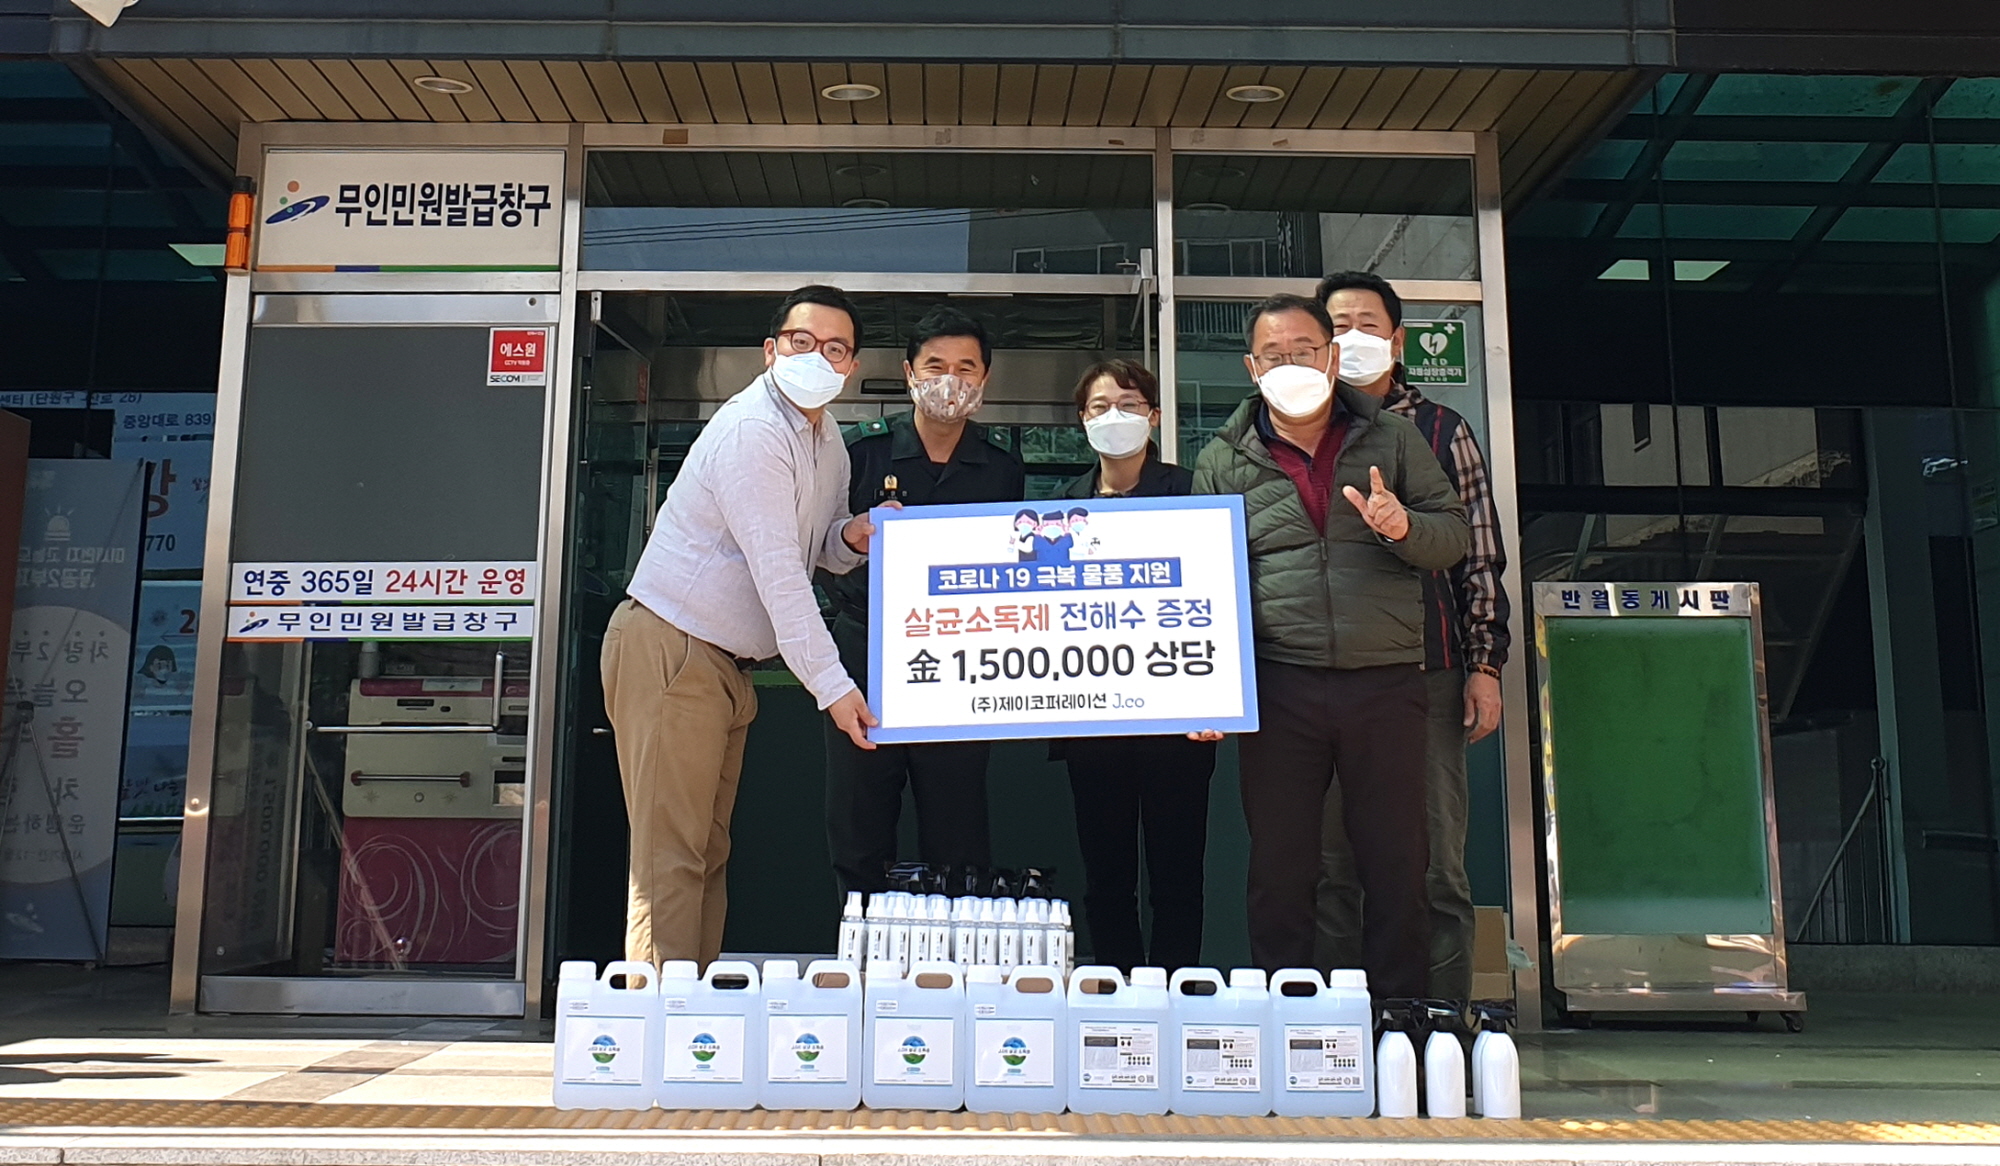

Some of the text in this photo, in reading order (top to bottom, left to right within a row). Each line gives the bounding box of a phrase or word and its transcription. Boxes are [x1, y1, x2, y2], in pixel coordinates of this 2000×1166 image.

[335, 182, 551, 227] 무인민원발급창구
[500, 342, 536, 357] 에스원
[1408, 367, 1462, 377] 자동심장충격기
[1422, 357, 1448, 367] AED
[490, 374, 520, 383] SECOM
[124, 414, 180, 429] 중앙대로
[243, 567, 526, 596] 연중 365일 24시간 운영
[938, 562, 1171, 591] 코로나 19 극복 물품 지원
[1561, 589, 1730, 611] 반월동게시판
[277, 611, 518, 632] 무인민원발급창구
[904, 598, 1213, 638] 살균소독제 전해수 증정
[906, 640, 1216, 684] 金 1,500,000 상당
[971, 692, 1107, 714] (주)제이코퍼레이션
